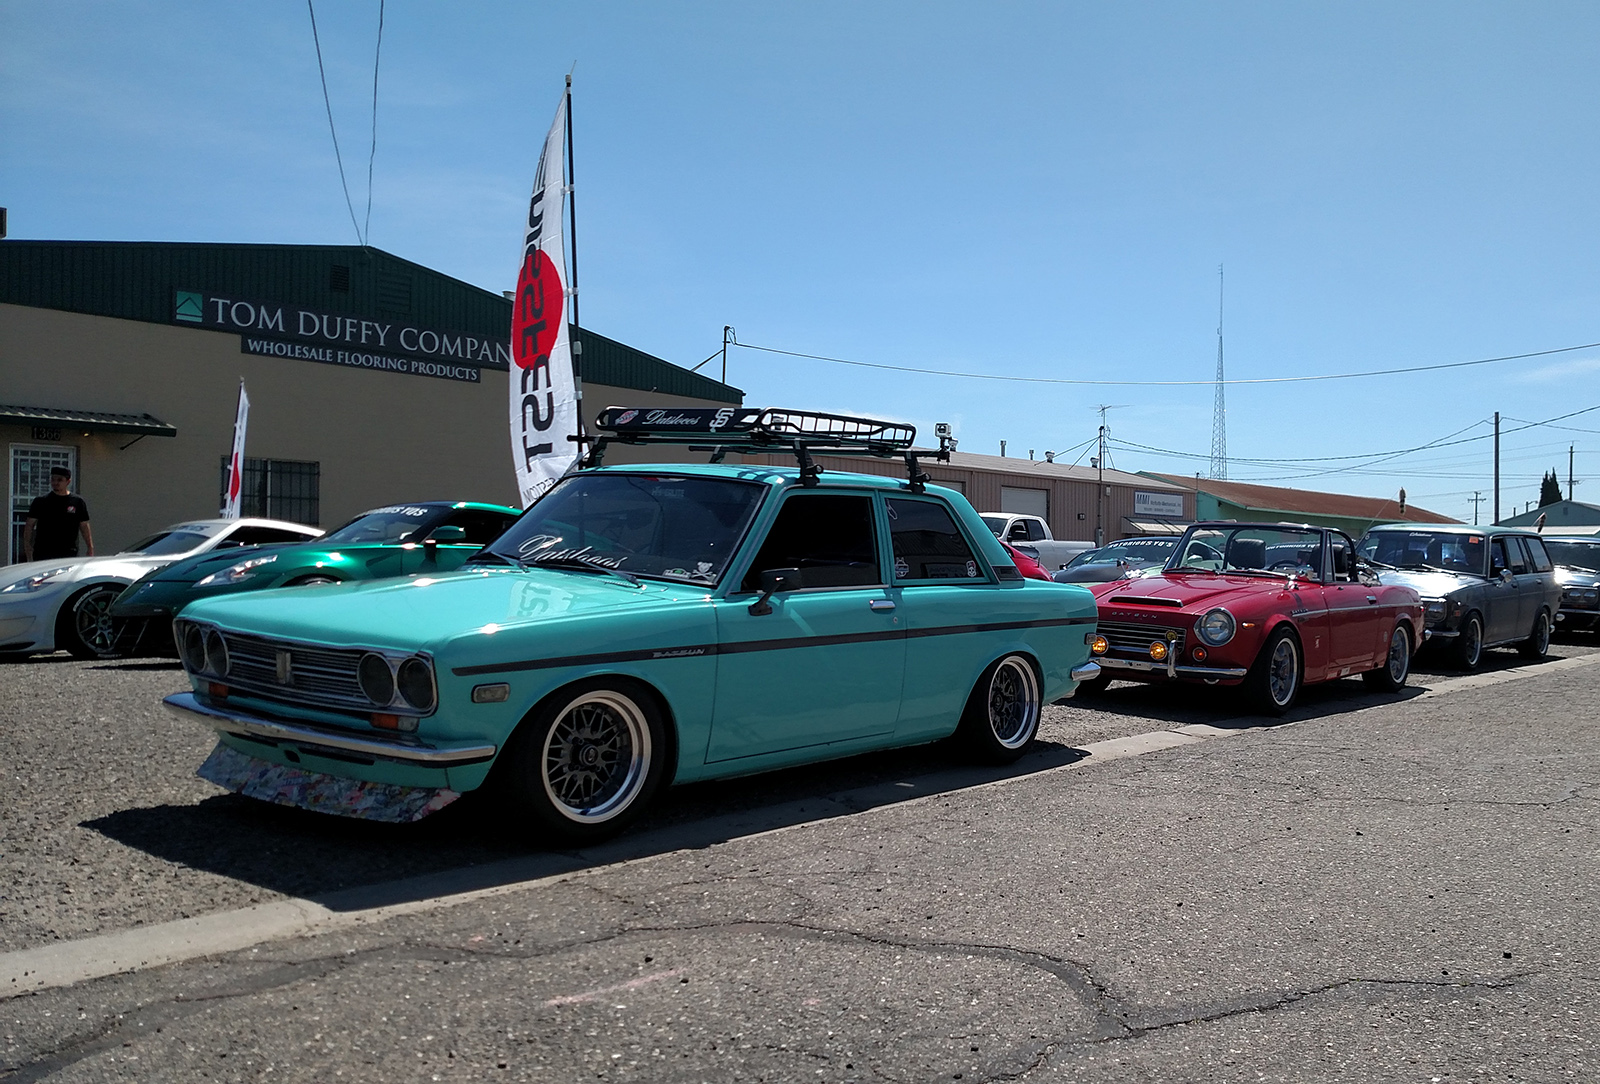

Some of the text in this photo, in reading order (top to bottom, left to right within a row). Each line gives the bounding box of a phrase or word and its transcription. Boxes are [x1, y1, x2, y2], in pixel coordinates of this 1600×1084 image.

[209, 297, 511, 364] TOM DUFFY COMPAN
[247, 338, 478, 381] WHOLESALE FLOORING PRODUCTS
[33, 426, 61, 440] 1366
[1111, 611, 1158, 619] DATSUN
